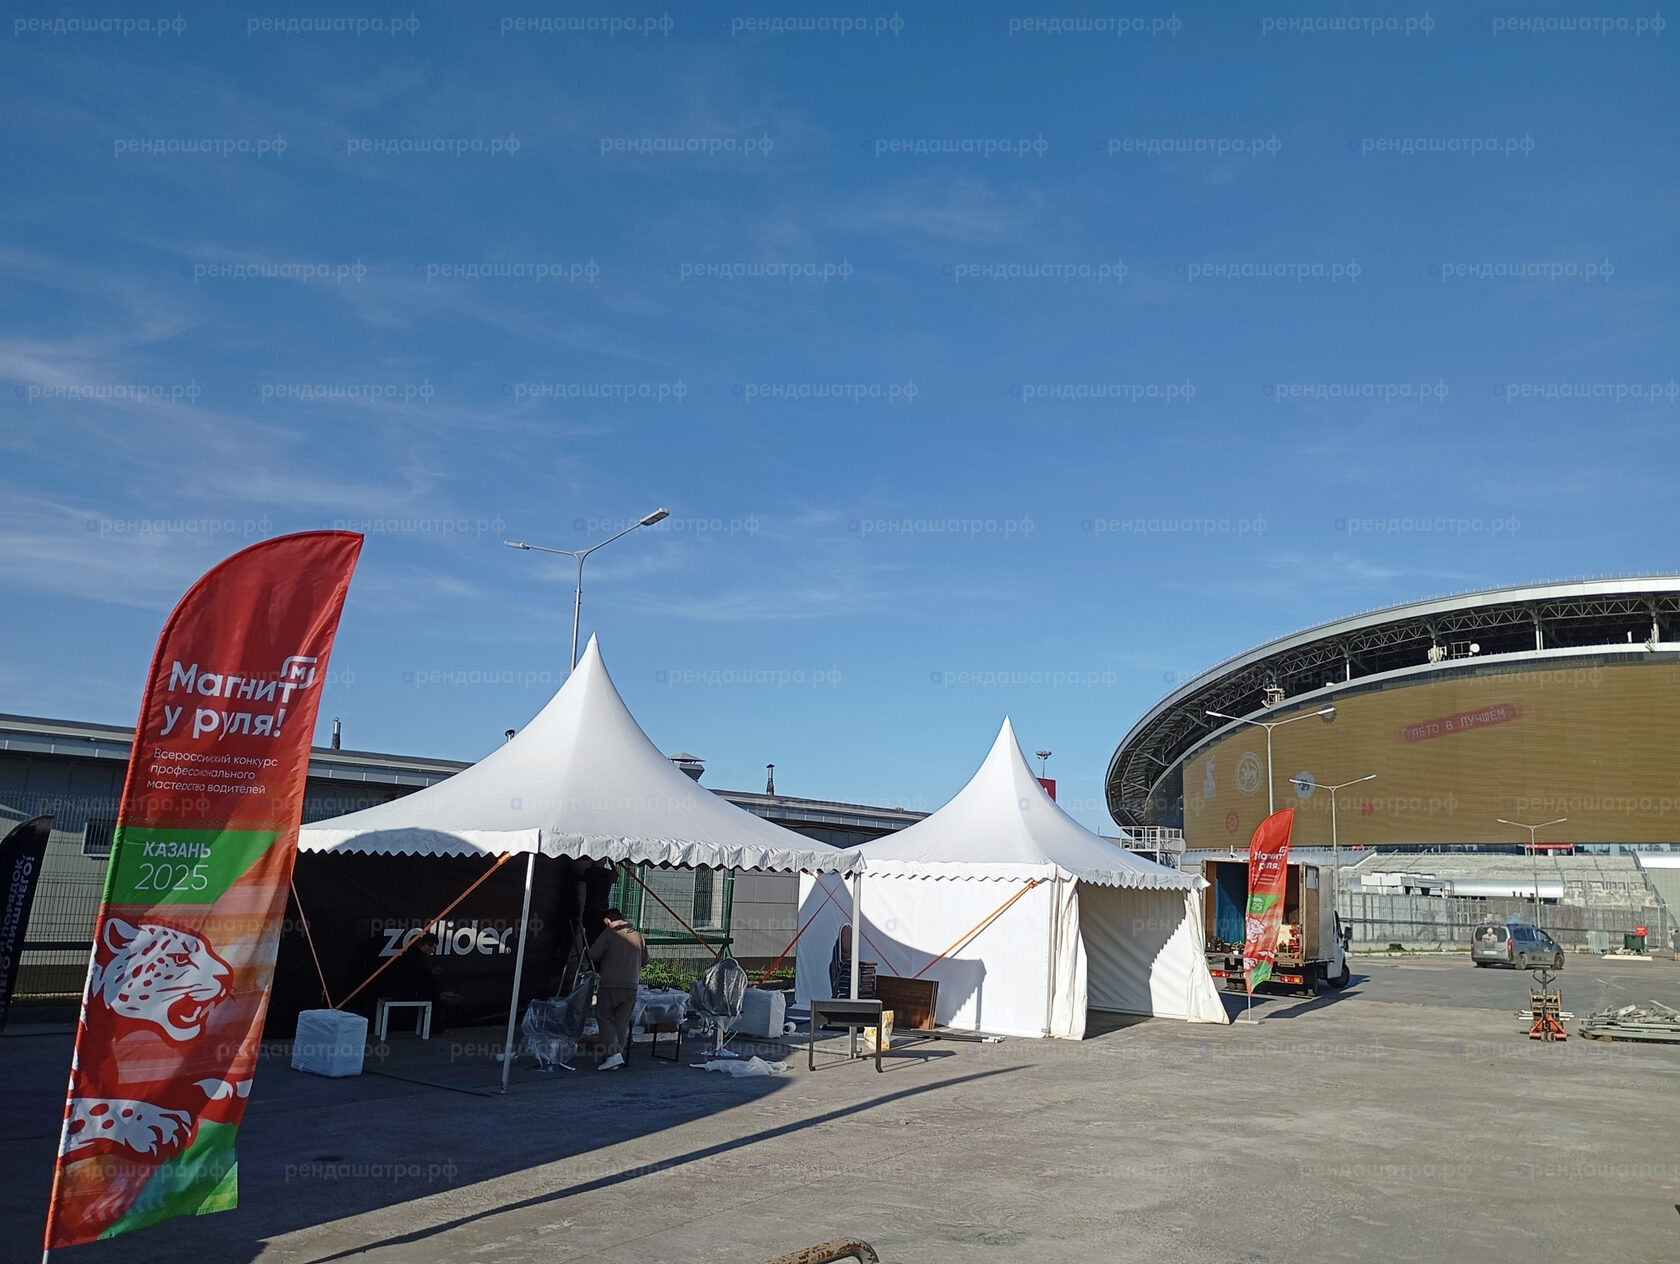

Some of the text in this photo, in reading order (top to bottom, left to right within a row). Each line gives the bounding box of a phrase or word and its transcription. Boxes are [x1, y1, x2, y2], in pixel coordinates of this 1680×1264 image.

[168, 660, 298, 704] Магнит
[160, 705, 287, 741] у руля!
[233, 755, 278, 769] конкурс
[207, 783, 266, 795] водителей
[143, 841, 211, 858] КАЗАНЬ
[134, 863, 208, 890] 2025
